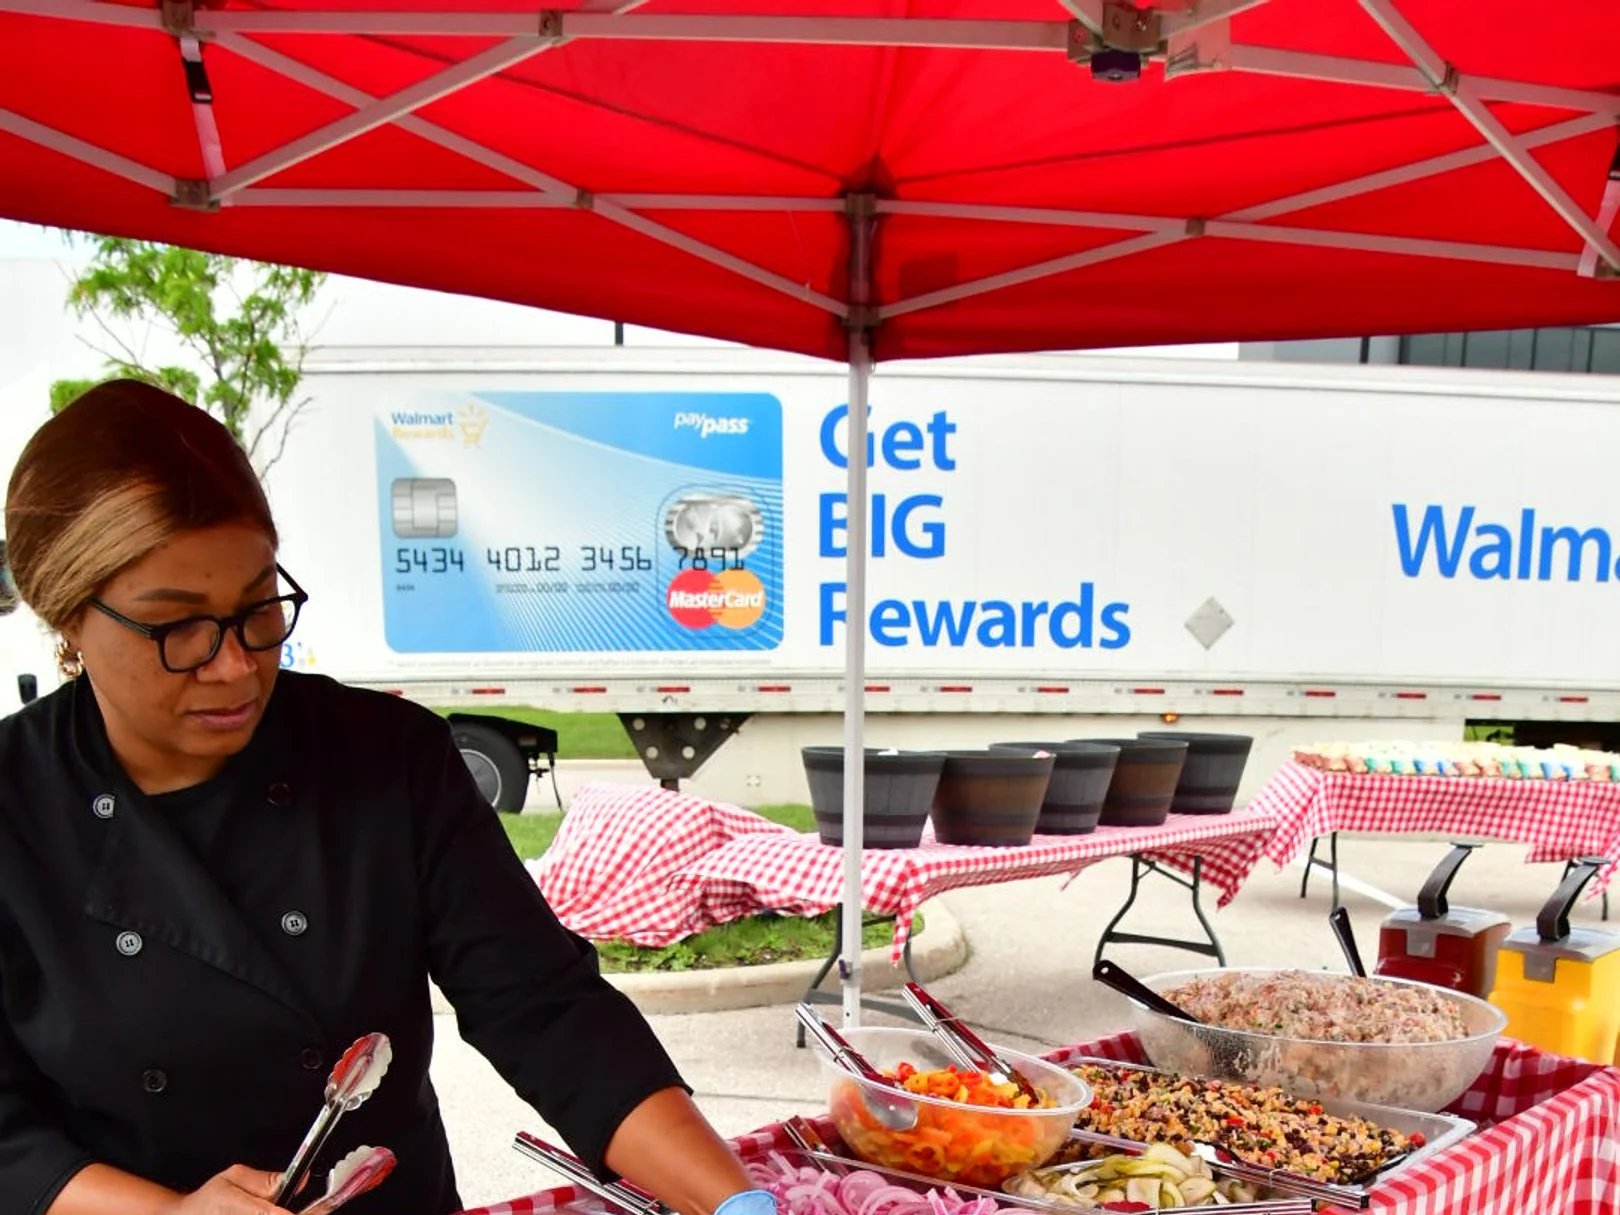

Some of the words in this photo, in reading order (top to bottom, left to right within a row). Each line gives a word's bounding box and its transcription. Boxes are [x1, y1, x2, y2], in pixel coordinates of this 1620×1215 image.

[391, 411, 454, 425] Walmart
[819, 402, 957, 471] Get
[818, 492, 946, 559] BIG
[1391, 503, 1620, 583] Walm
[395, 547, 465, 574] 5434
[487, 546, 561, 572] 4012
[580, 545, 652, 572] 3456
[672, 545, 745, 571] 7891
[669, 590, 763, 609] MasterCard
